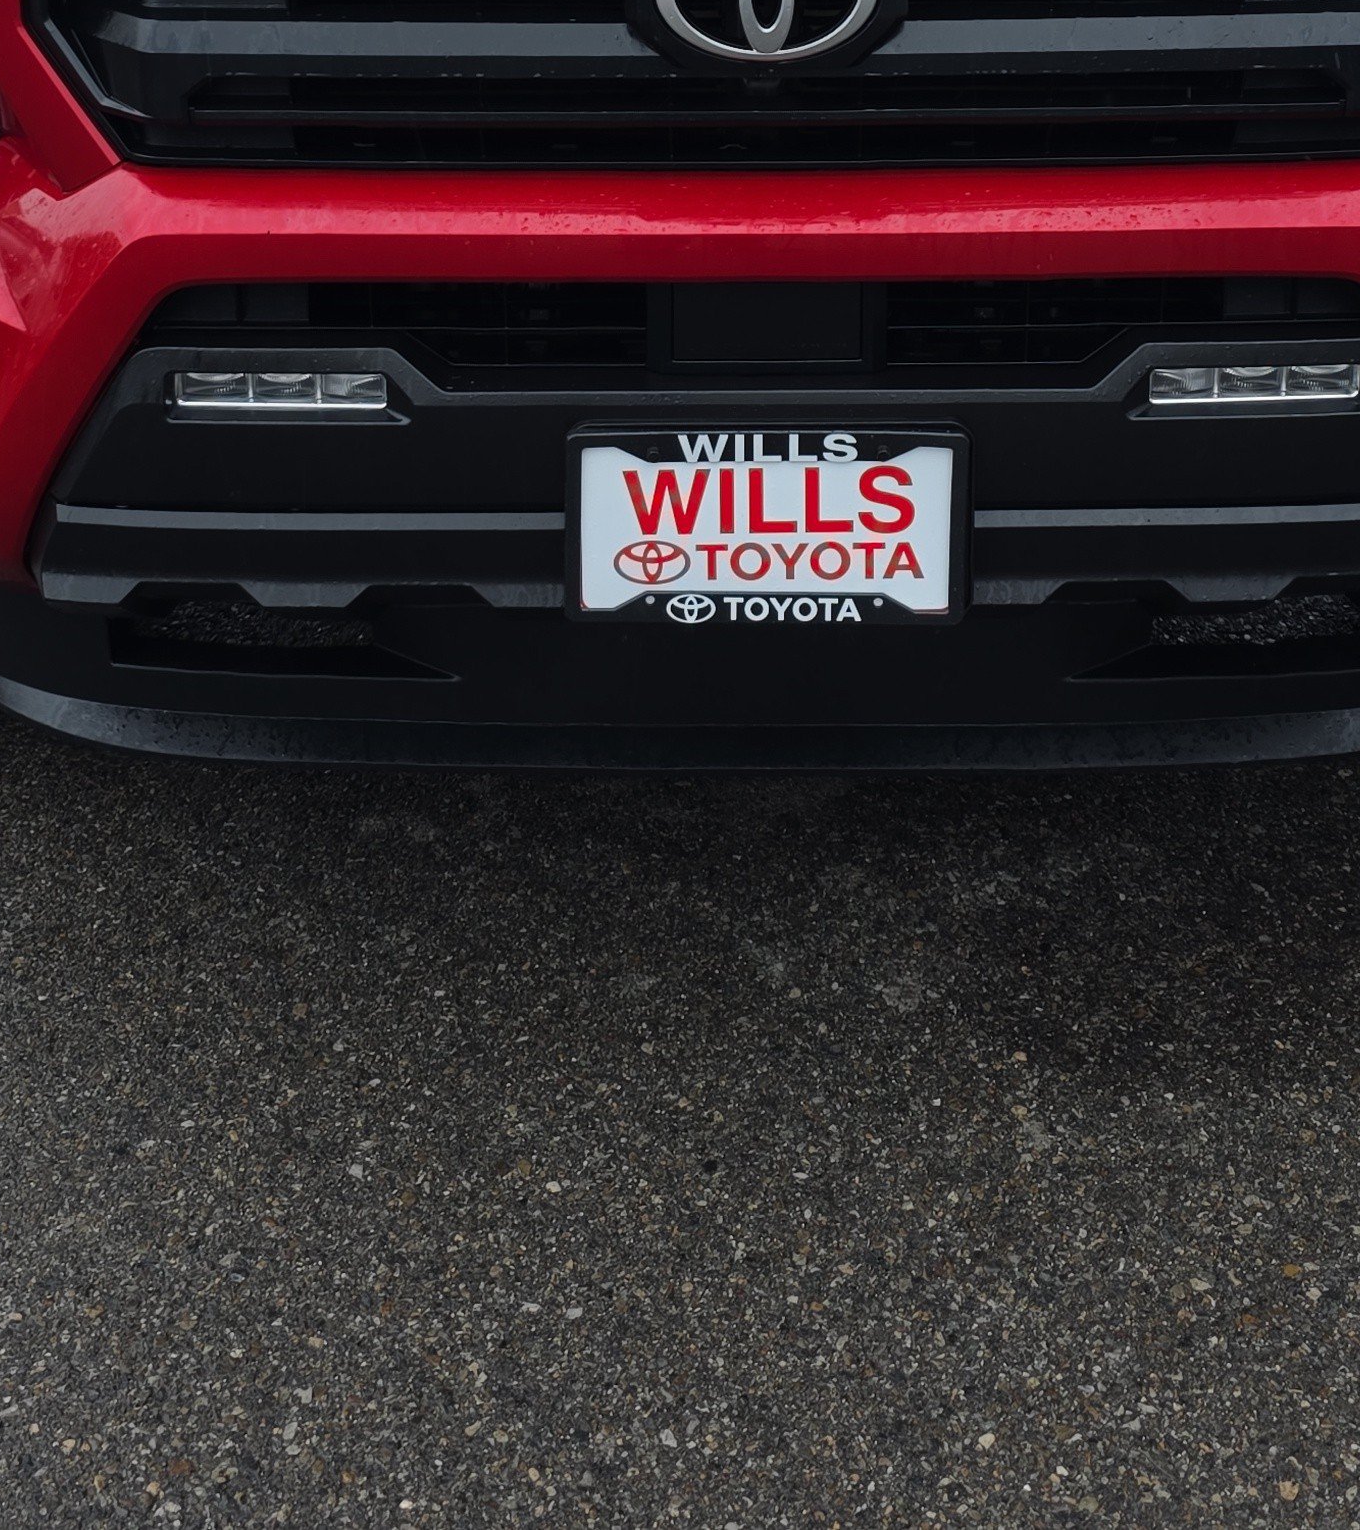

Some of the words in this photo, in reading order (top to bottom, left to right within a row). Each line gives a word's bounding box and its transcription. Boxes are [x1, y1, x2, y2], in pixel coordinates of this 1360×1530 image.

[677, 434, 858, 463] WILLS
[622, 466, 915, 535] WILLS
[695, 541, 925, 580] TOYOTA
[724, 597, 862, 622] TOYOTA
